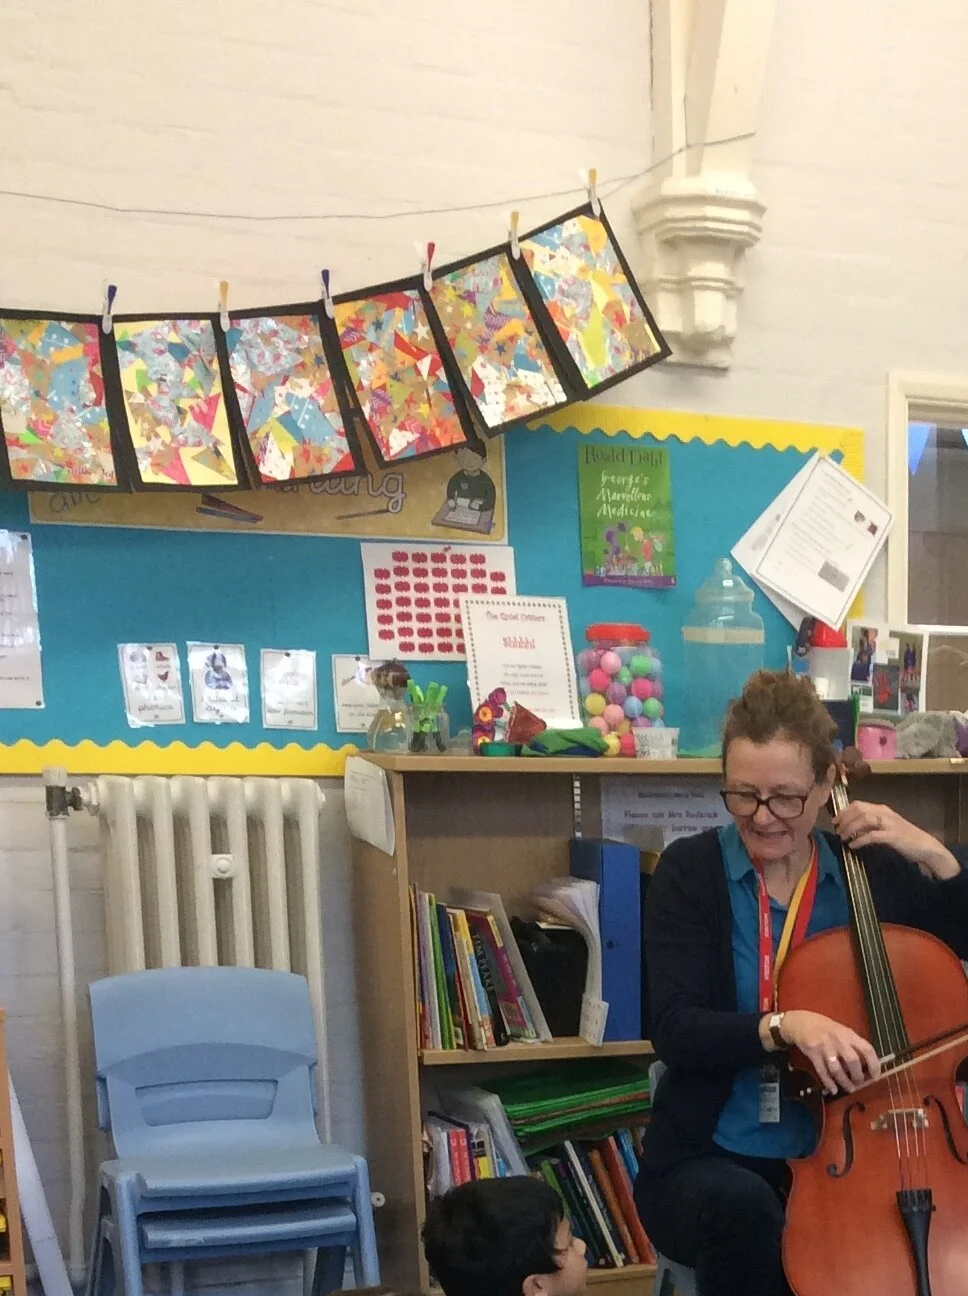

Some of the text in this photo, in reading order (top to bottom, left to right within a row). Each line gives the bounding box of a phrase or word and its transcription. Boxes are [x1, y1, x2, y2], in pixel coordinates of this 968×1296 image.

[585, 444, 663, 468] Roald Dahl
[601, 470, 650, 491] George's
[596, 503, 656, 519] Medicine
[624, 810, 649, 819] Please
